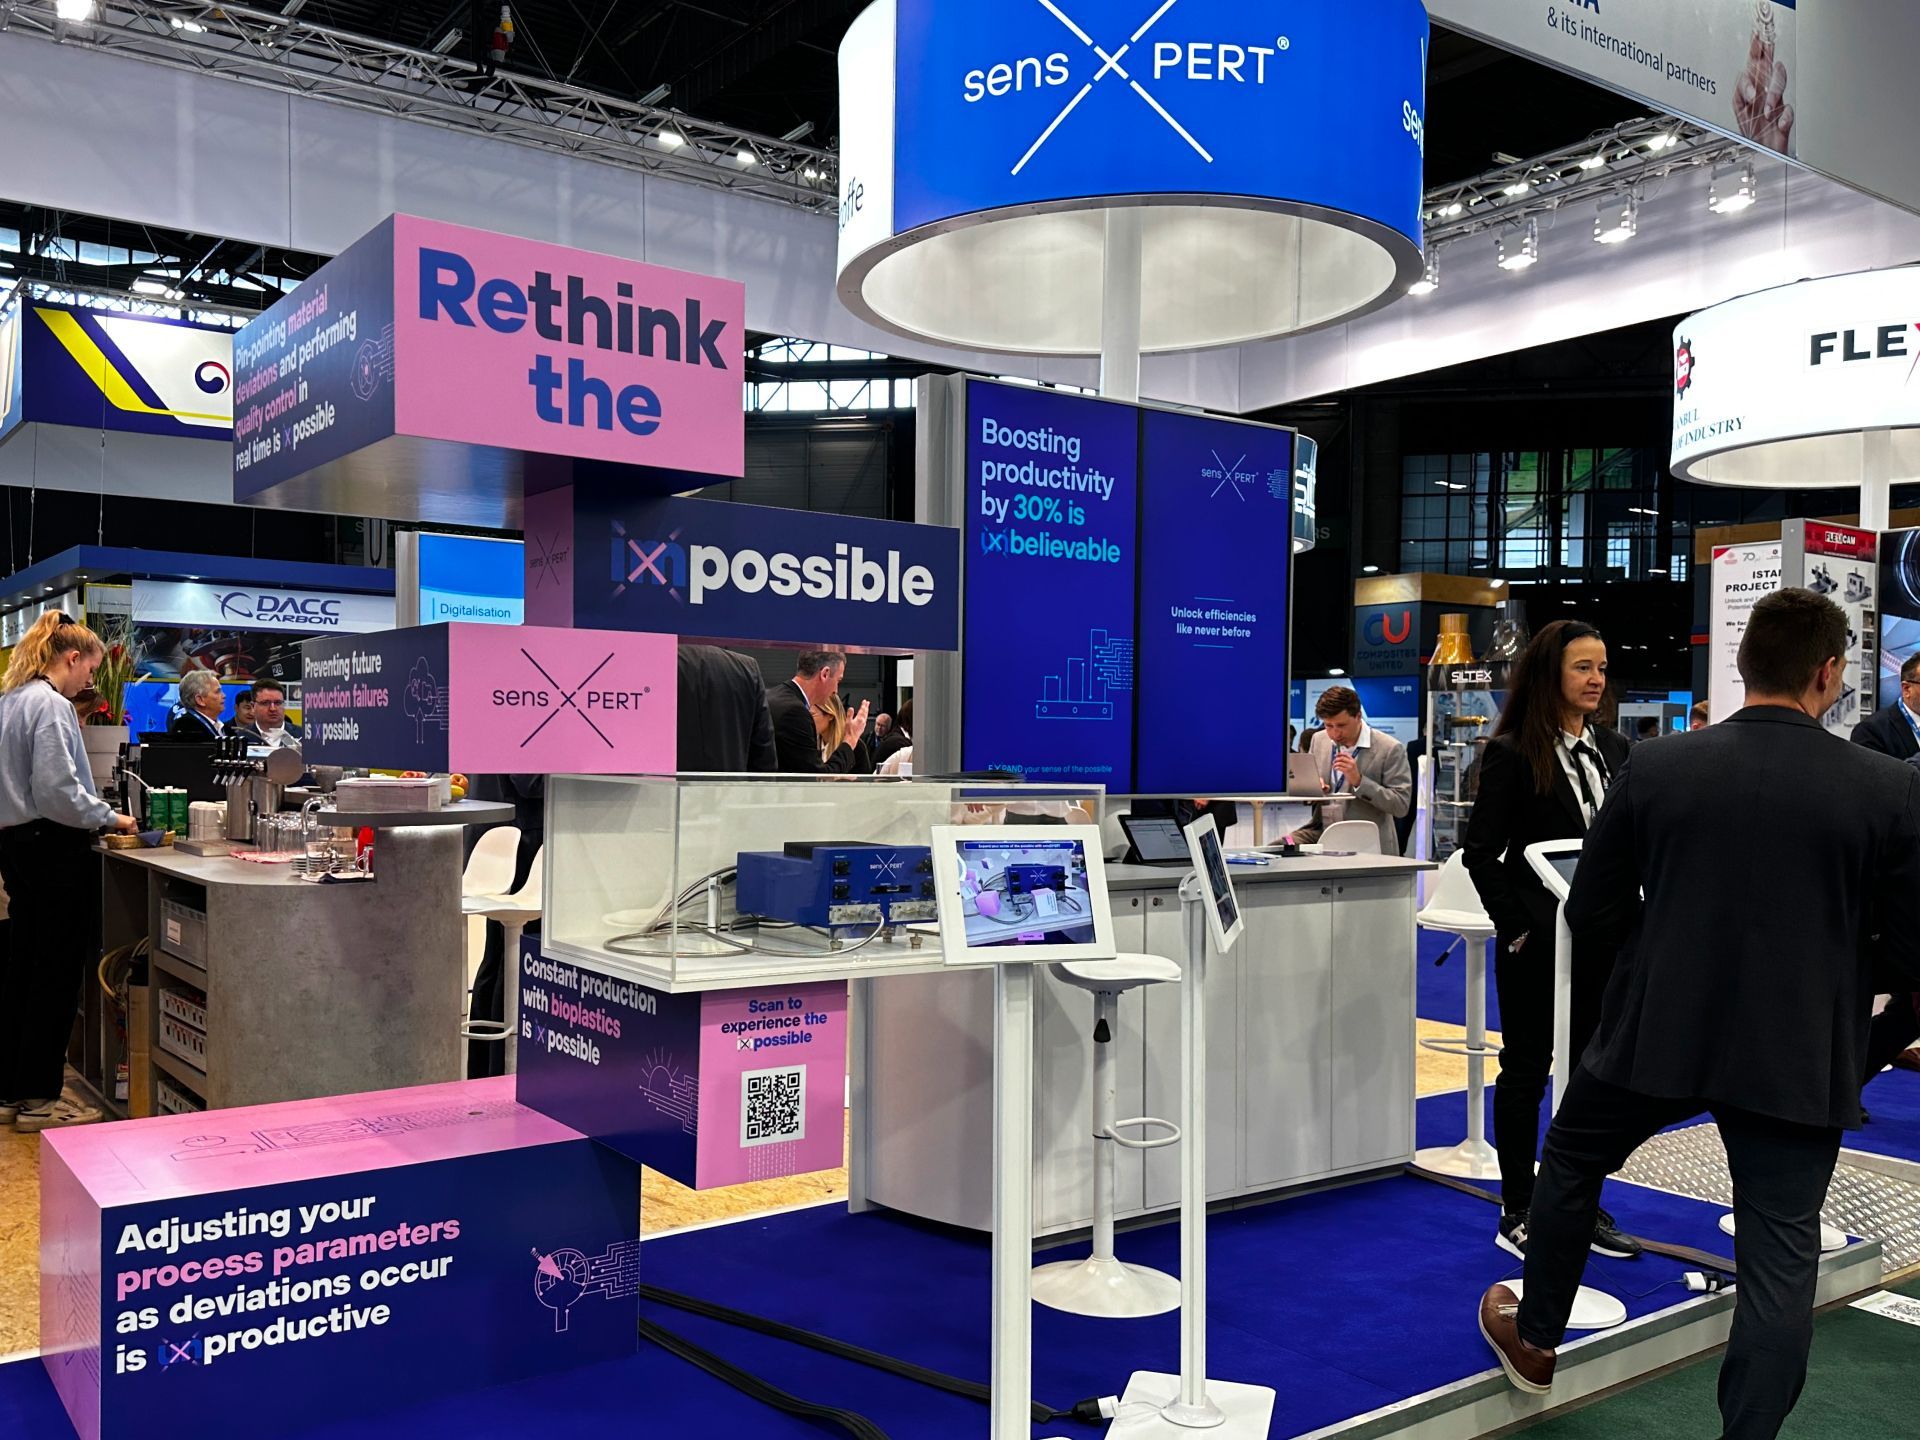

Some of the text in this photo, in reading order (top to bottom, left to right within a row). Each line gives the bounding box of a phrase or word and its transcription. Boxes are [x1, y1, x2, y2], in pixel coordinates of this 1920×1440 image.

[1547, 6, 1558, 29] &
[1561, 12, 1577, 36] its
[1581, 20, 1663, 72] international
[1667, 61, 1717, 95] partners
[839, 176, 864, 231] offe
[419, 247, 728, 370] Rethink
[236, 284, 328, 372] Pin-pointing material
[236, 310, 357, 405] deviations and performing
[236, 376, 308, 442] quality control in
[528, 354, 662, 436] the
[982, 417, 1081, 463] Boosting
[1685, 416, 1746, 445] INDUSTRY
[236, 441, 251, 471] real
[253, 435, 271, 463] time
[273, 427, 281, 453] is
[981, 460, 1115, 501] productivity
[981, 490, 1085, 525] by 30% is
[1726, 582, 1777, 593] PROJECT
[256, 613, 339, 625] CARBON
[257, 595, 341, 616] DACC
[440, 603, 511, 619] Digitalisation
[1171, 606, 1257, 622] Unlock efficiencies
[1176, 623, 1251, 638] like never before
[304, 651, 382, 681] Preventing future
[1369, 660, 1404, 671] UNITED
[304, 685, 351, 714] production
[353, 683, 388, 707] failures
[304, 718, 311, 739] is
[1024, 766, 1040, 774] your
[1063, 764, 1071, 773] of
[1072, 764, 1083, 773] the
[1085, 765, 1113, 774] possible
[523, 952, 657, 1016] Constant production
[523, 985, 621, 1039] with bioplastics
[749, 997, 802, 1014] Scan to
[522, 1014, 532, 1039] is
[721, 1012, 828, 1035] experience the
[115, 1196, 376, 1254] Adjusting your
[117, 1218, 461, 1302] process parameters
[116, 1256, 453, 1334] as deviations occur
[116, 1344, 147, 1374] is
